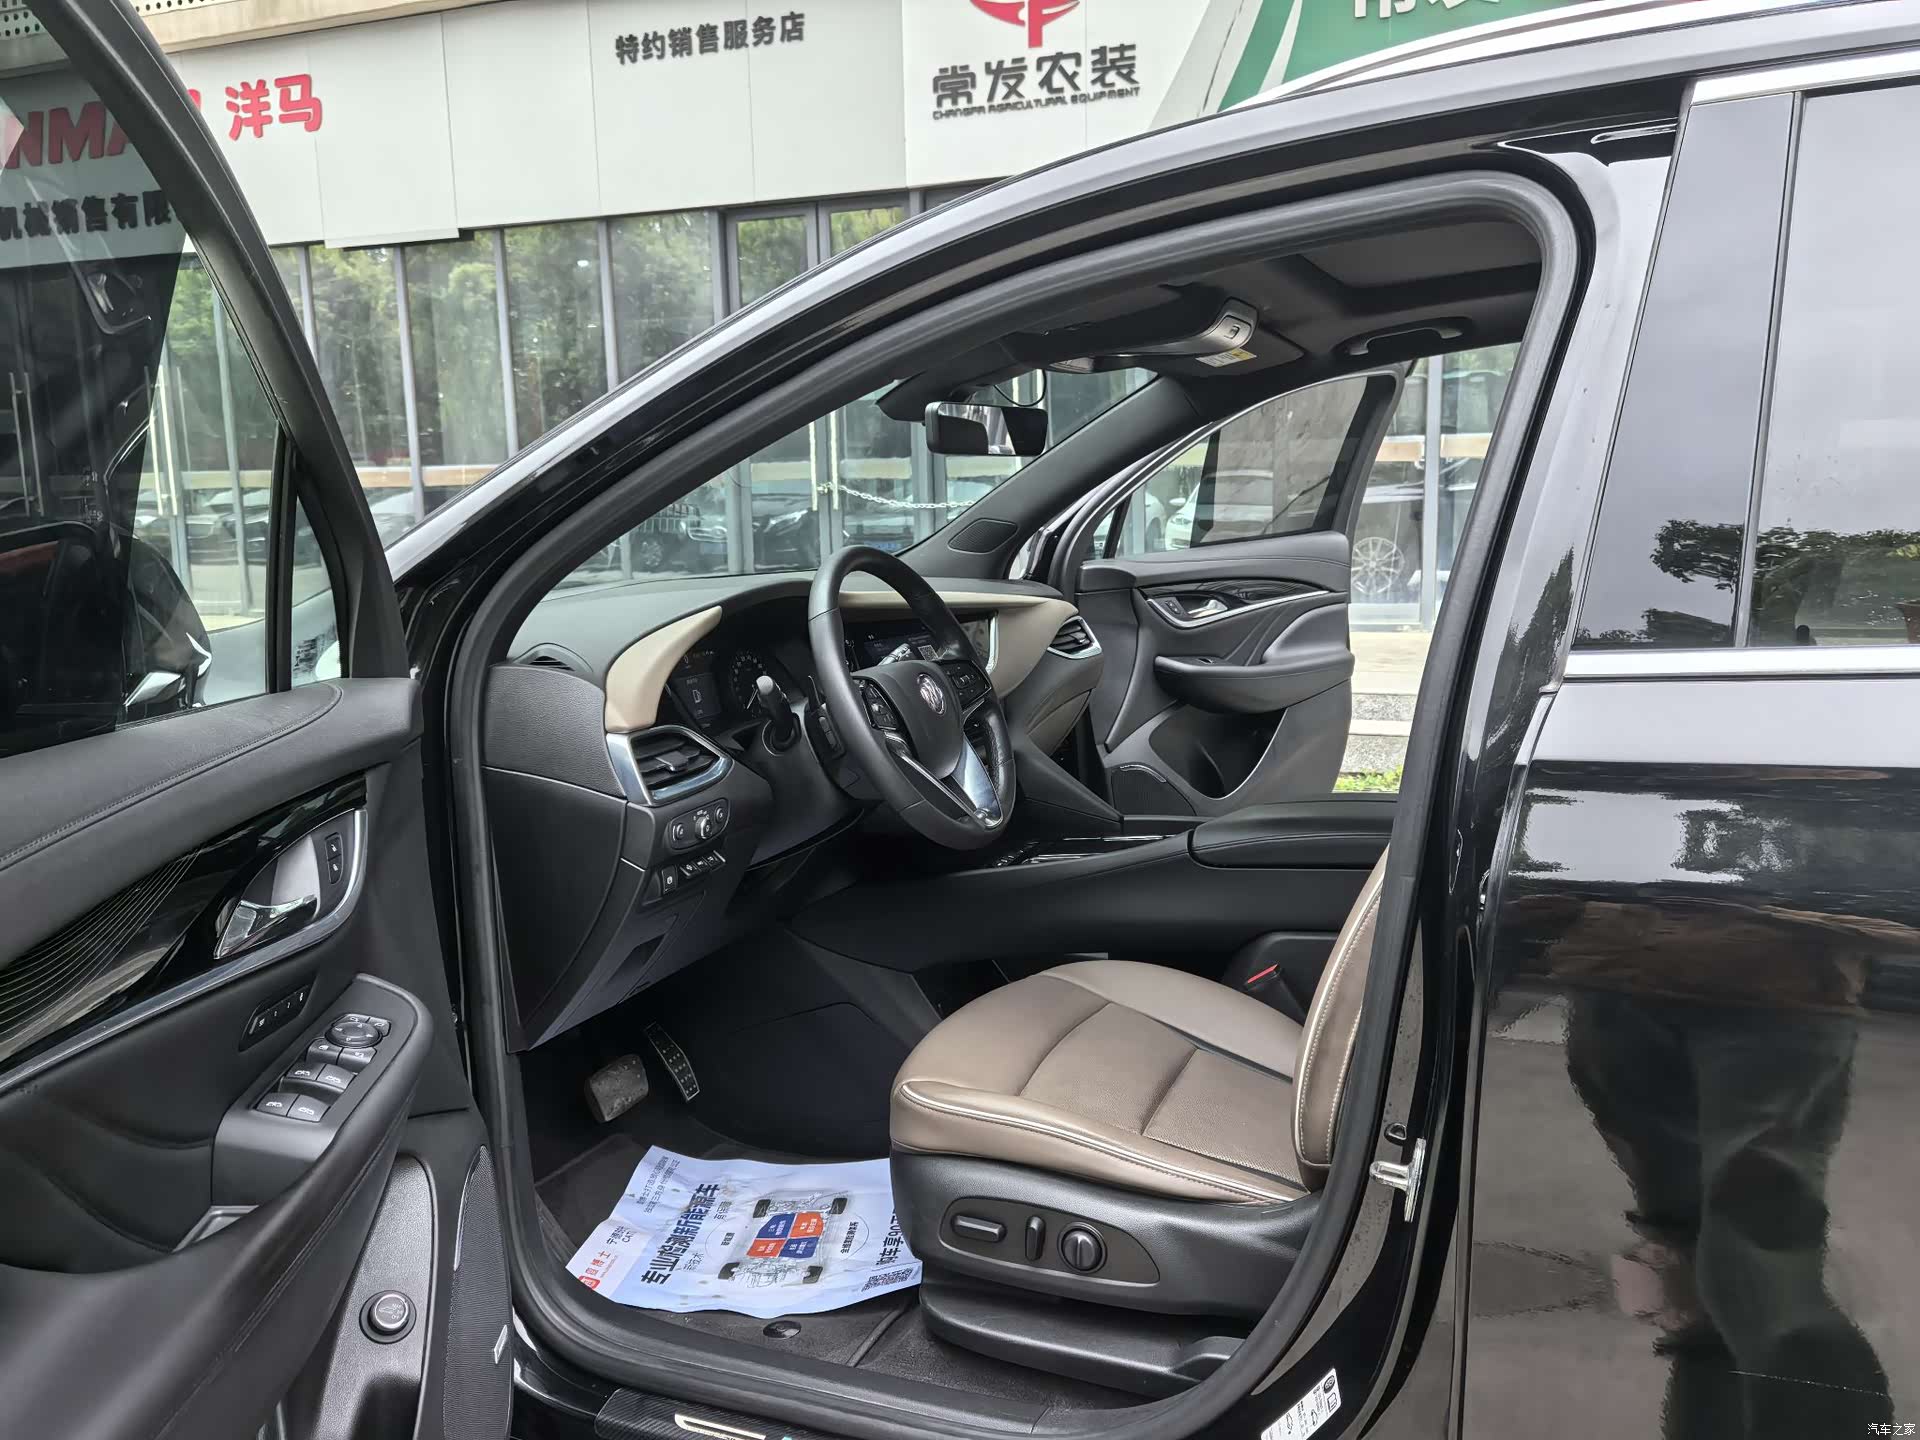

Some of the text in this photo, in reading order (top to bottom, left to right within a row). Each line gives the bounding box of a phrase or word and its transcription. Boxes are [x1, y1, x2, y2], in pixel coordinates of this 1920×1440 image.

[615, 11, 805, 65] 特约销售服务店
[225, 73, 323, 141] 洋马
[932, 43, 1140, 109] 常发农装
[641, 1184, 720, 1284] 专业检测新能源车
